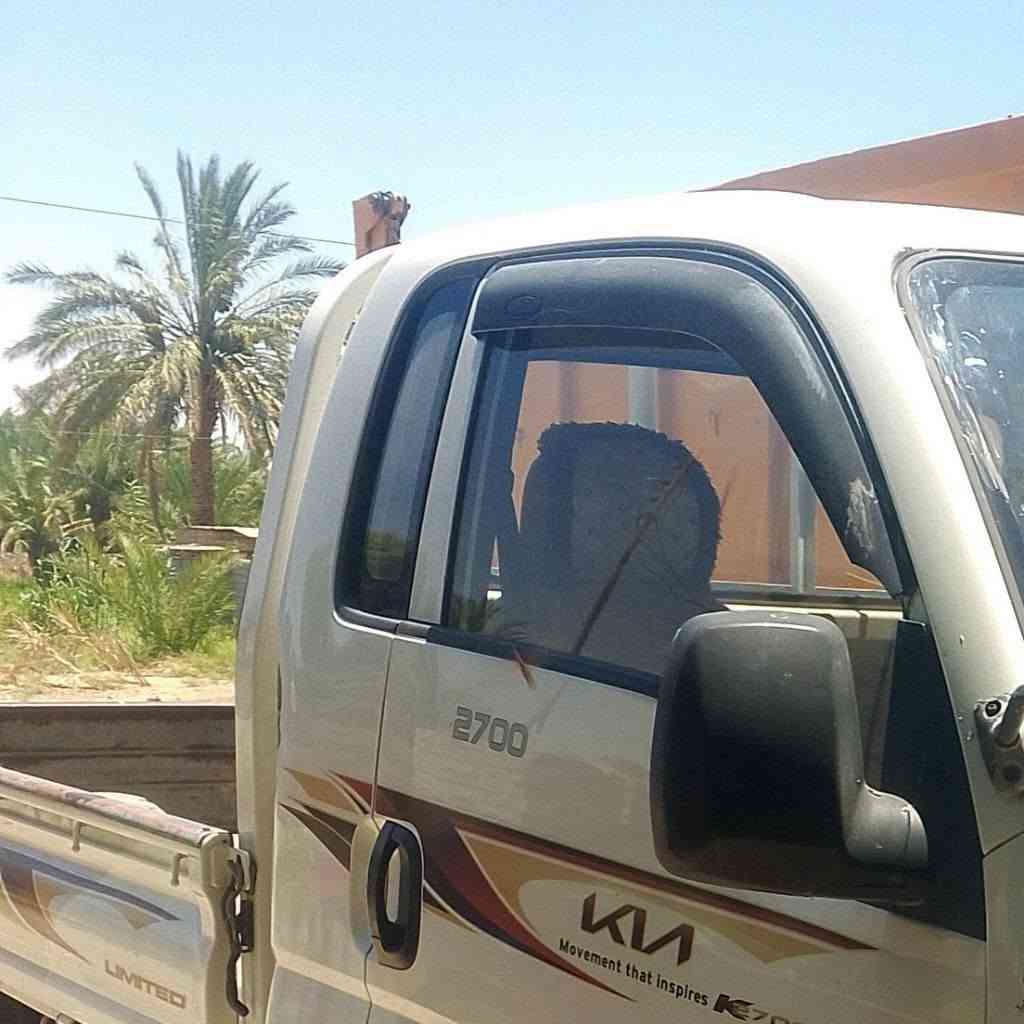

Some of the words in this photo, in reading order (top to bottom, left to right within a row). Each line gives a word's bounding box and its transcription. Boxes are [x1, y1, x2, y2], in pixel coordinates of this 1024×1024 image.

[452, 705, 529, 758] 2700
[580, 891, 695, 967] KIA
[104, 959, 187, 1010] LIMITED
[558, 937, 621, 973] Movement
[625, 962, 652, 985] that
[656, 974, 709, 1006] inspires
